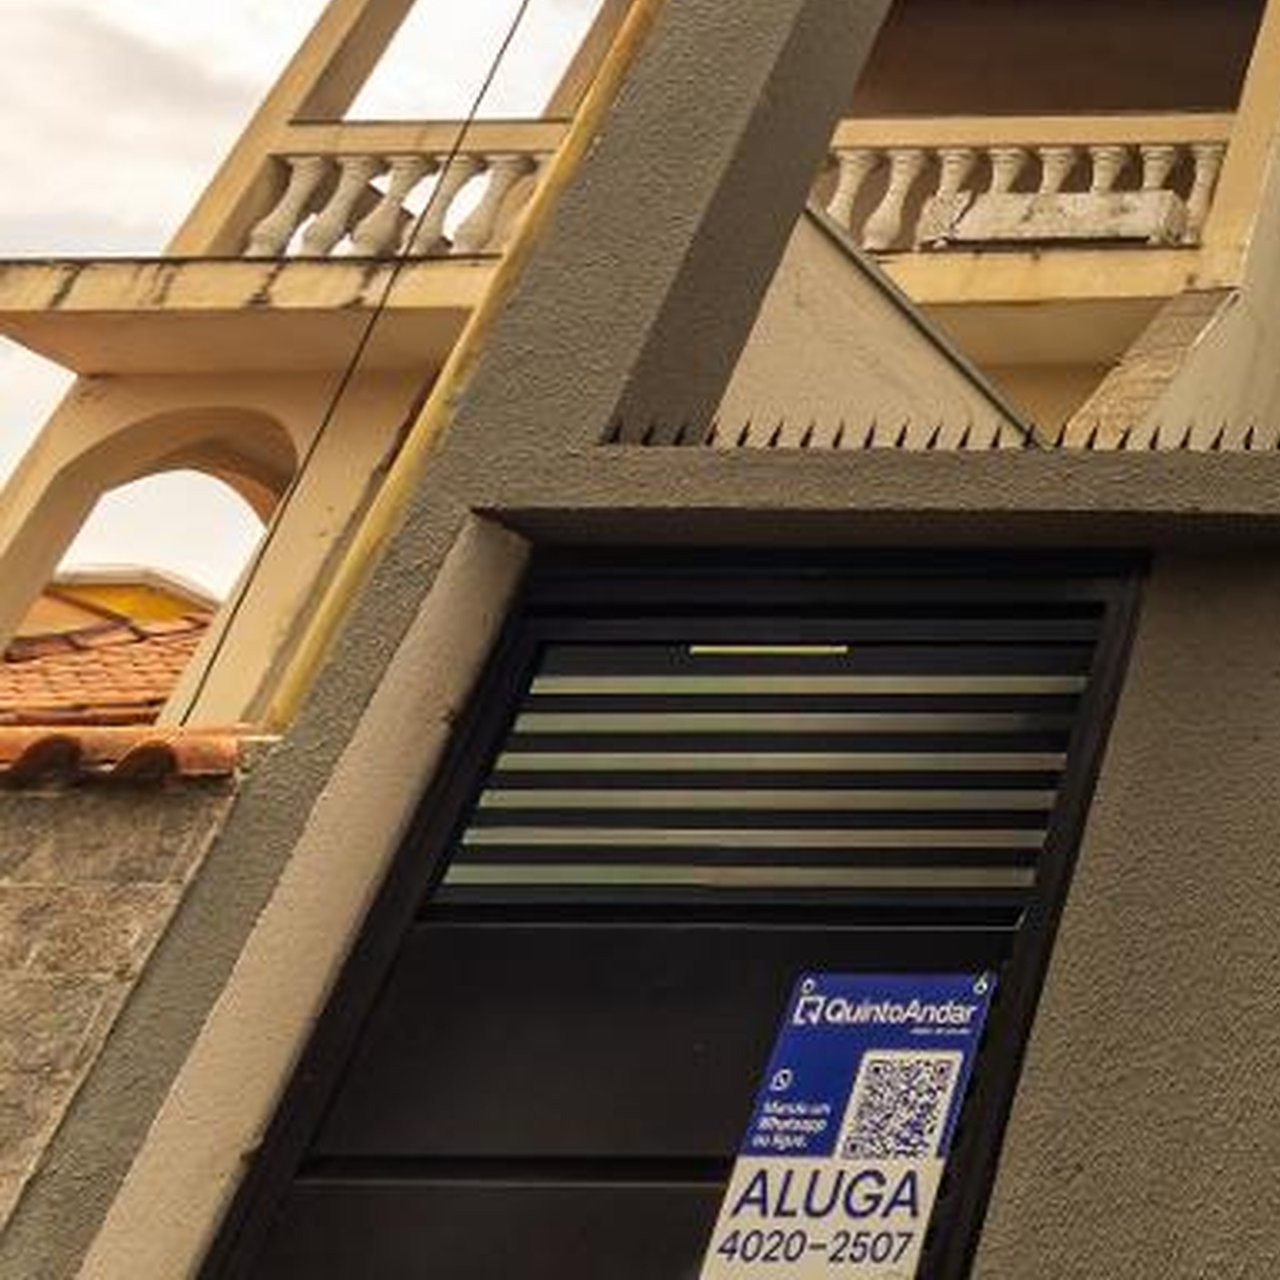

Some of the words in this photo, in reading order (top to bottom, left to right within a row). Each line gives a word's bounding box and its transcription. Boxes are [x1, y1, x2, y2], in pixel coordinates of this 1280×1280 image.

[824, 998, 978, 1024] QuintoAndar
[731, 1169, 920, 1218] ALUGA
[718, 1229, 915, 1263] 4020-2507
